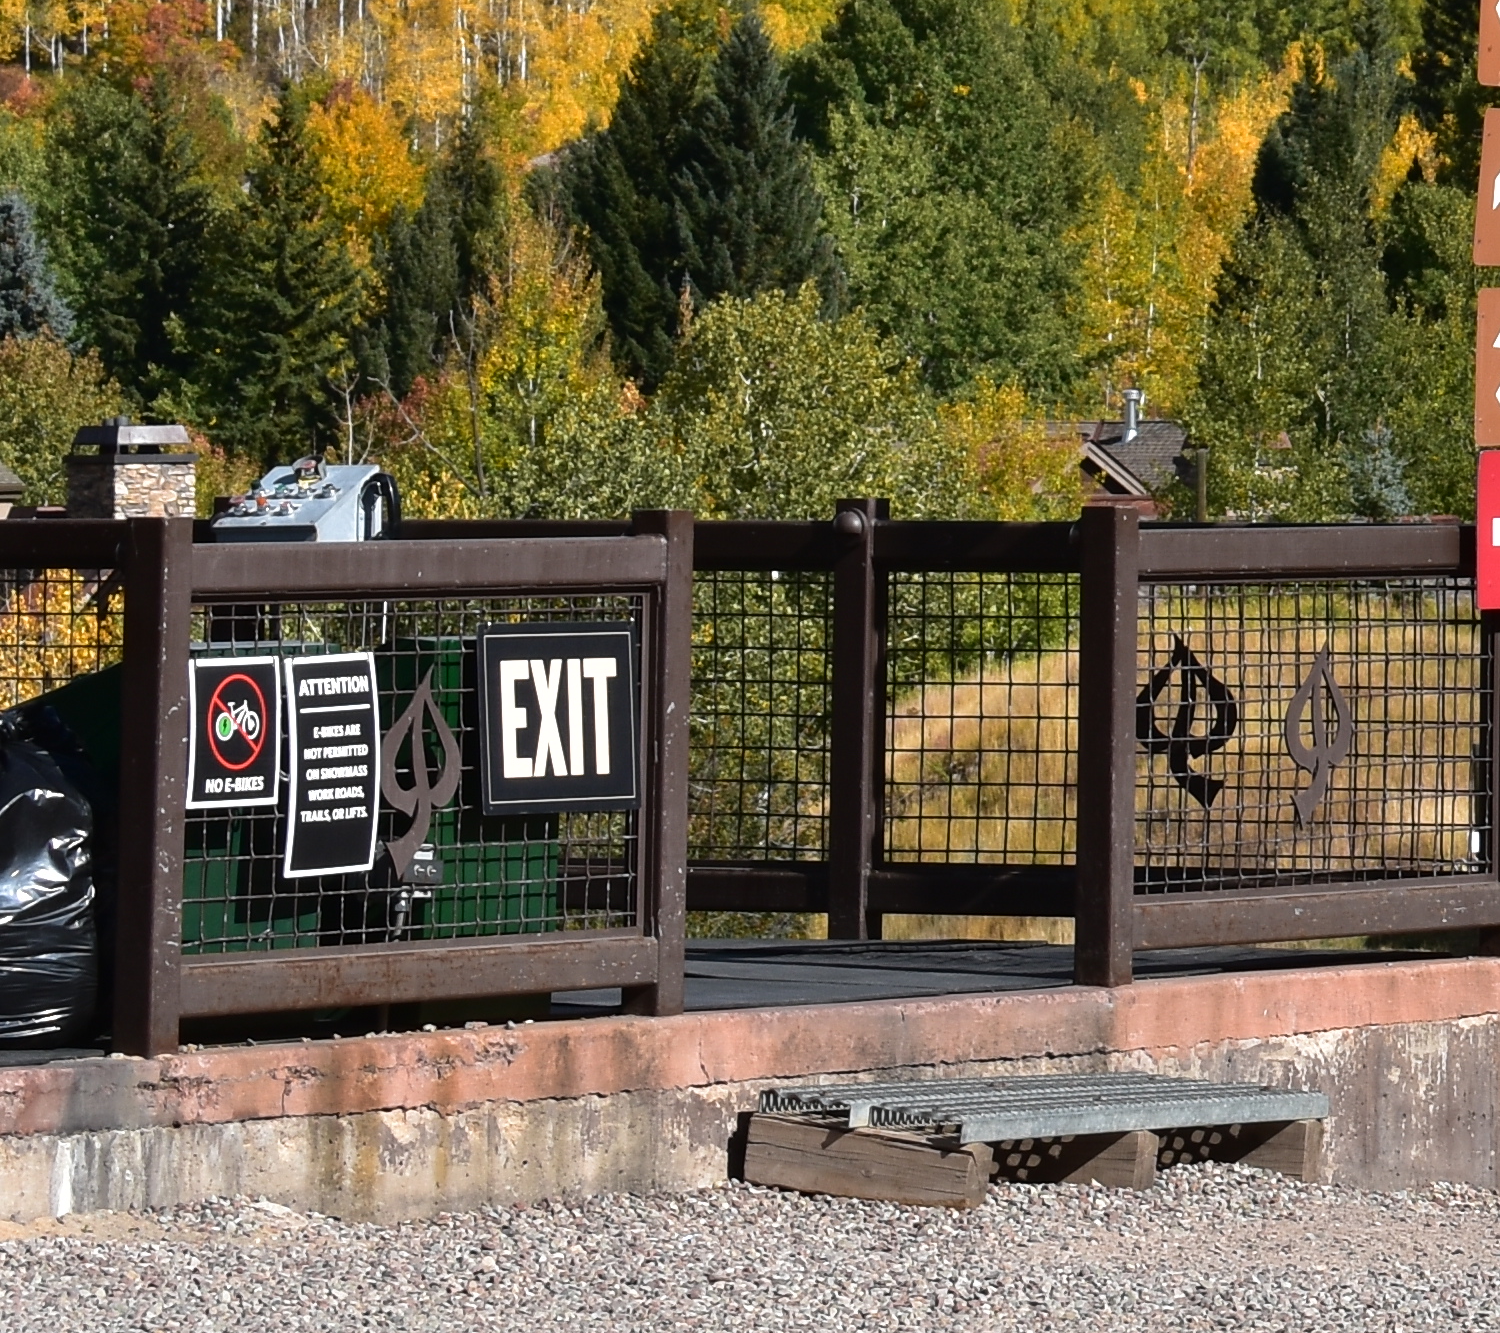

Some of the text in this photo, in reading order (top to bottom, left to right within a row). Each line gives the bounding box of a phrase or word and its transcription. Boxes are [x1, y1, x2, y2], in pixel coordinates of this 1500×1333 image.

[298, 675, 369, 697] ATTENTION
[499, 657, 617, 779] EXIT
[313, 723, 361, 738] E-BIKES ARE
[303, 744, 369, 760] NOT PERMITTED
[306, 765, 368, 781] ON SNOWMASS
[205, 775, 264, 793] NO E-BIKES
[308, 786, 365, 801] WORK ROADS,
[300, 806, 368, 823] TRAILS, OR LIFTS.
